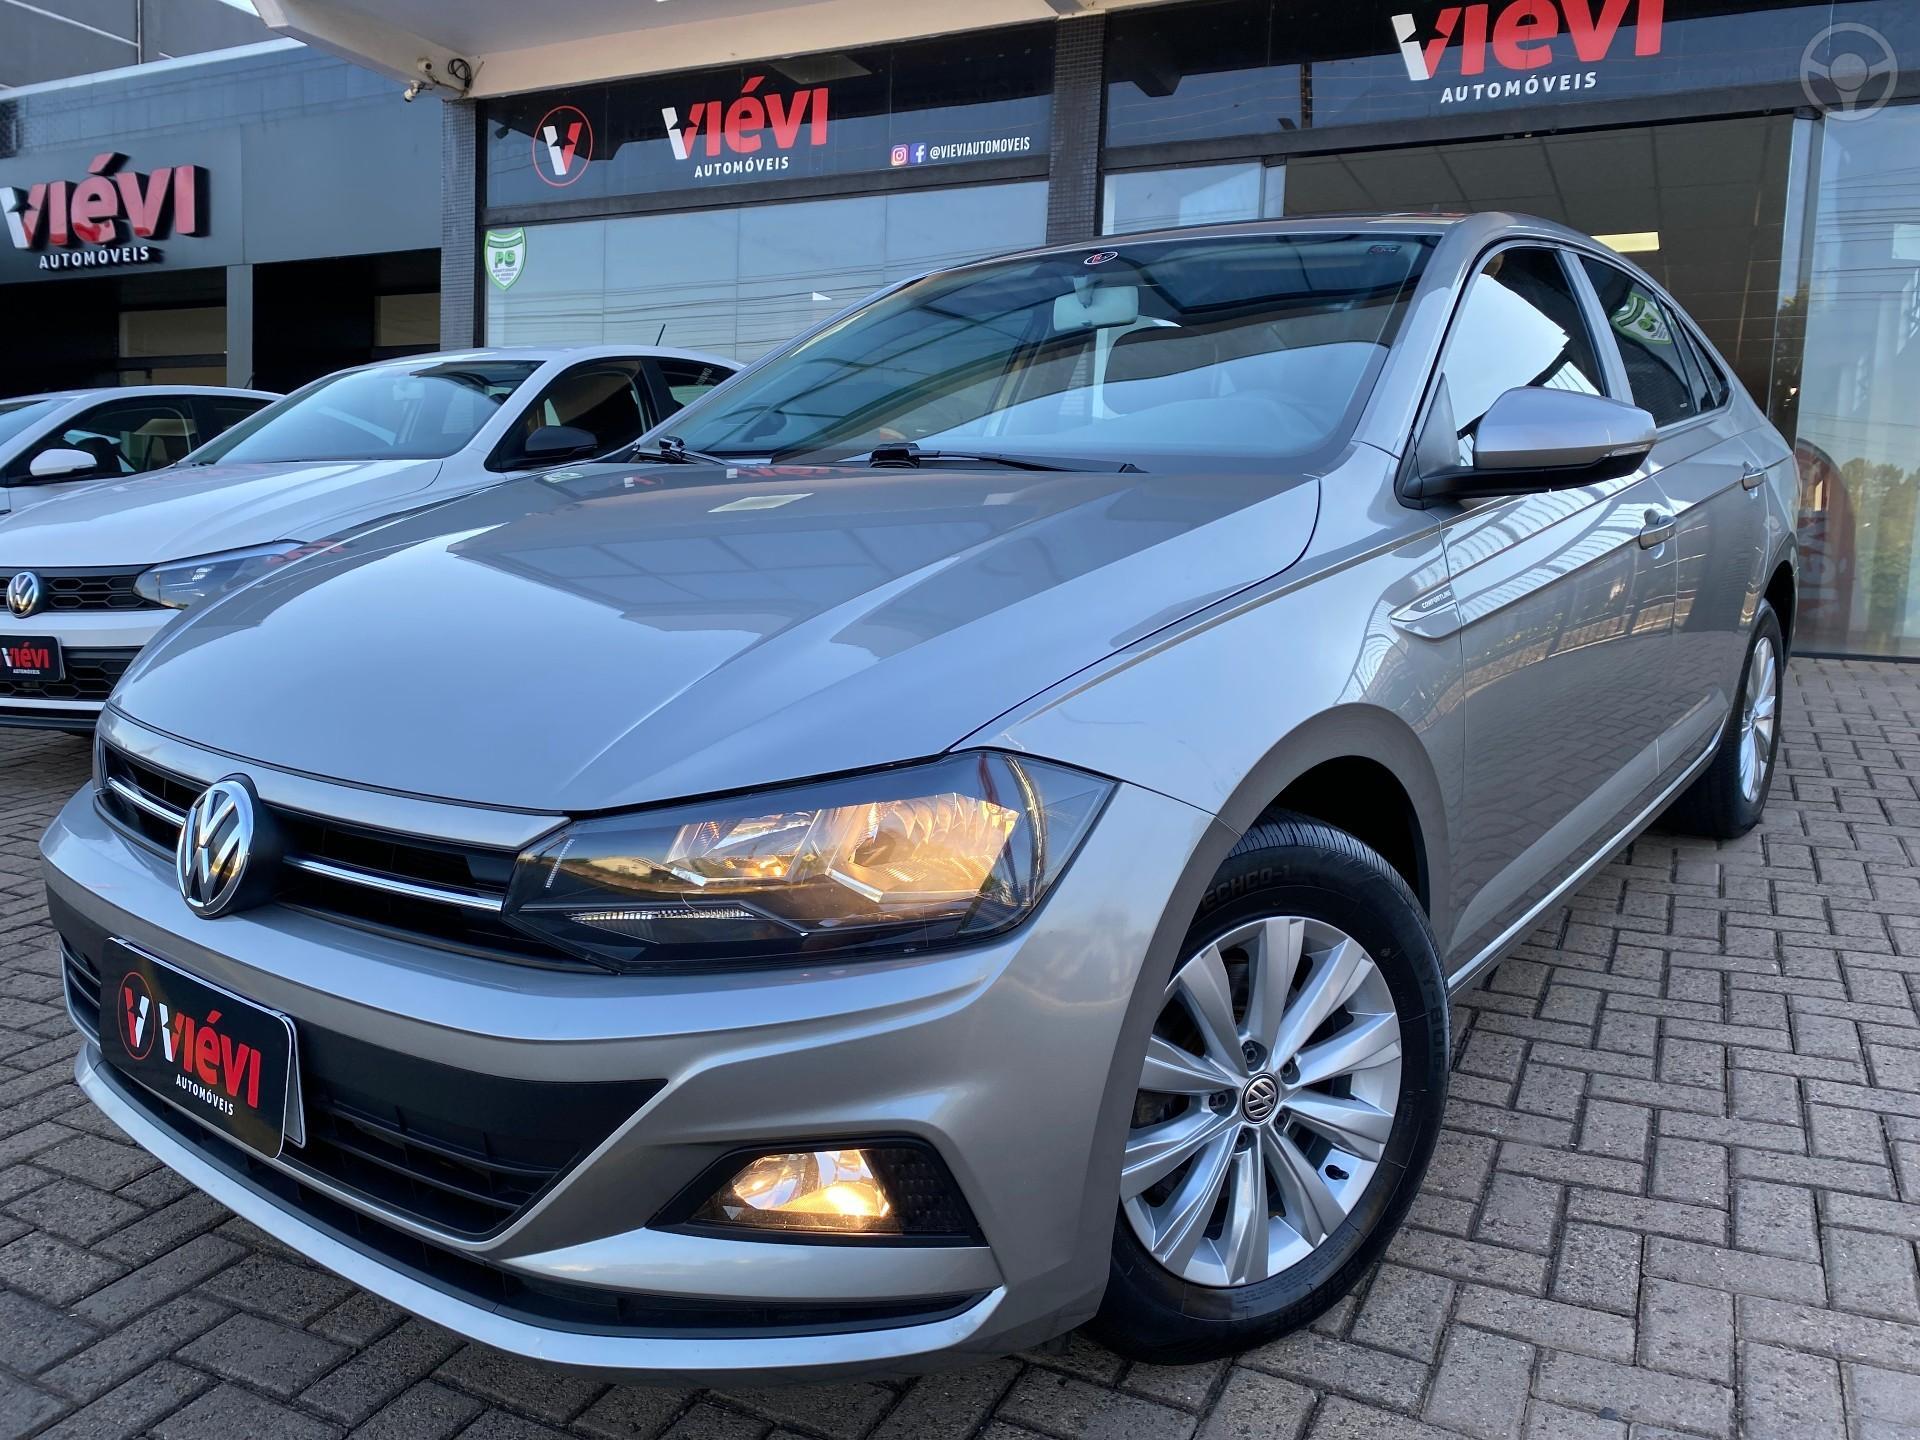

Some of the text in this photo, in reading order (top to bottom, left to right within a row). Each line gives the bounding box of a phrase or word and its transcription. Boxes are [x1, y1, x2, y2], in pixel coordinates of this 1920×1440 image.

[1440, 71, 1598, 104] AUTOMÓVEIS
[929, 136, 1031, 160] @VIEVIAUTOMOVEIS
[694, 156, 790, 178] AUTOMÓVEIS
[39, 244, 150, 270] AUTOMÓVEIS
[175, 1073, 234, 1117] AUTOMÓVEIS
